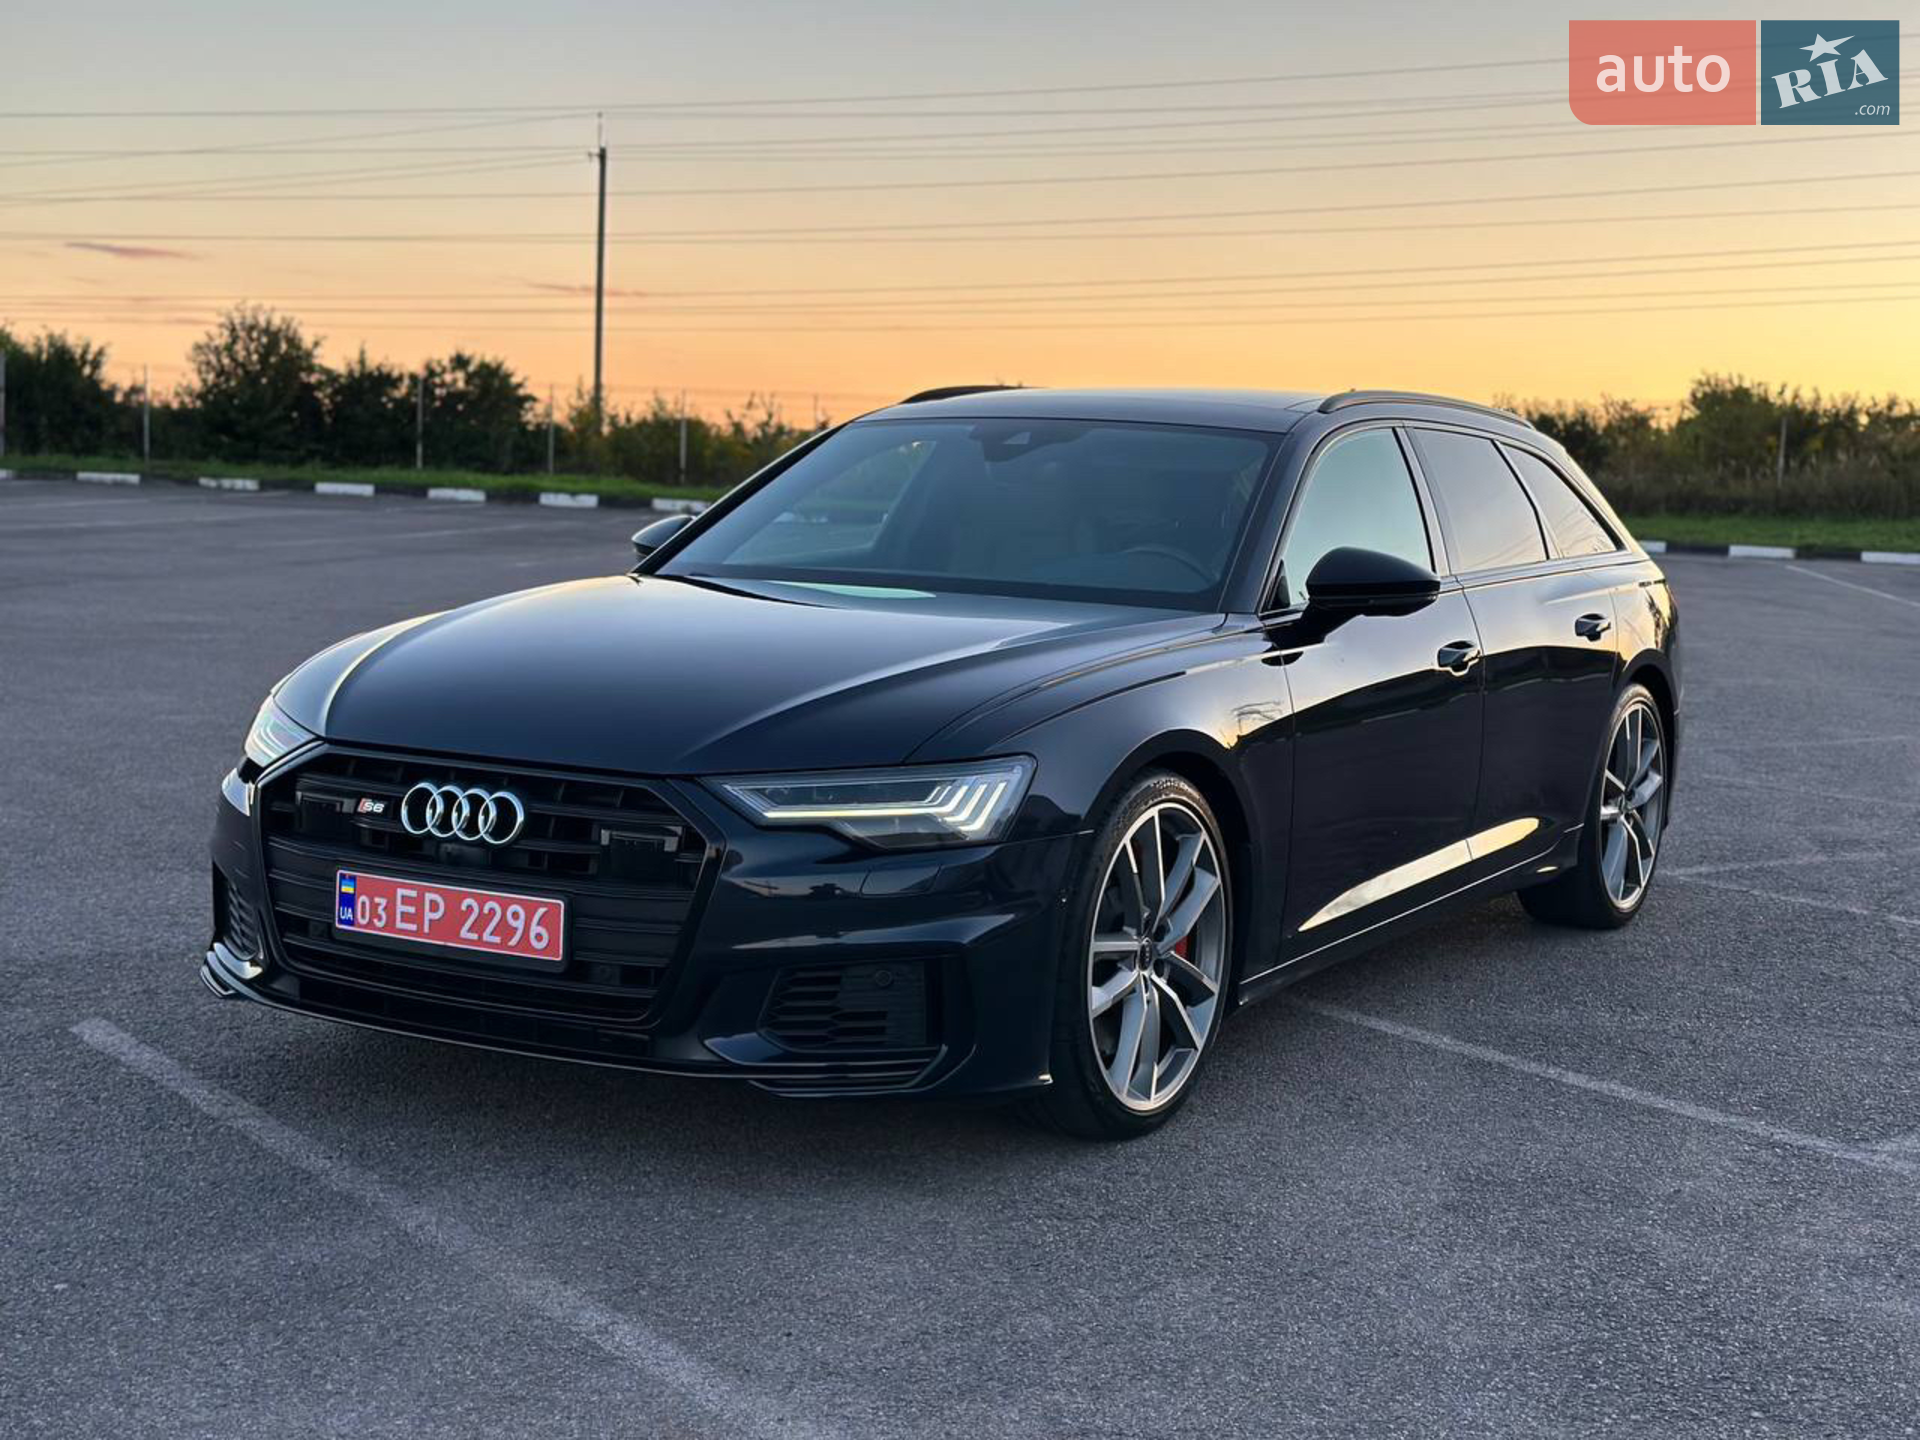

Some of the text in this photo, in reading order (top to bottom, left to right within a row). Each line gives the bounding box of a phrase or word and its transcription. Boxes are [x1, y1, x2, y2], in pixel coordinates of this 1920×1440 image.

[361, 800, 385, 813] S6
[339, 906, 354, 922] UA
[357, 887, 550, 950] 03 EP 2296
